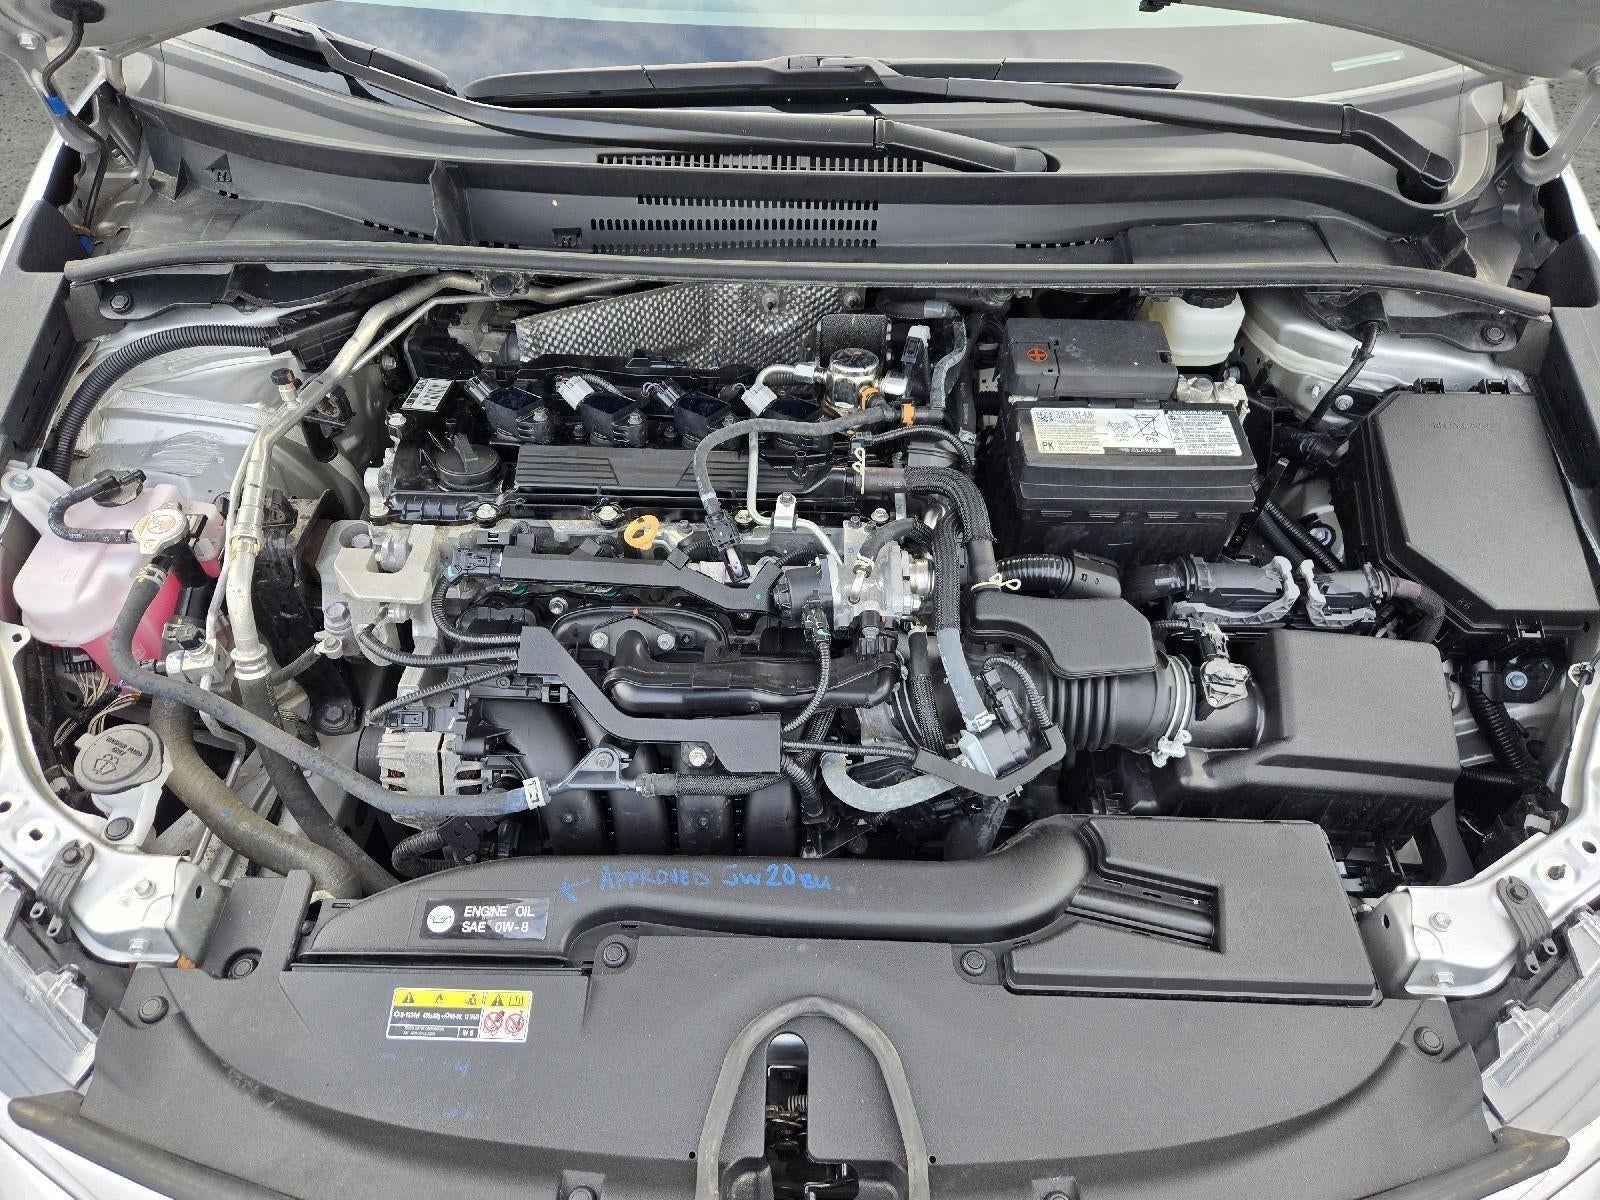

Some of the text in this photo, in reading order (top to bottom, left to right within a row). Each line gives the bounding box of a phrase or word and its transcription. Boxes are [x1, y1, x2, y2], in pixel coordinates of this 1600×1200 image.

[1042, 441, 1055, 450] PK
[463, 905, 535, 917] ENGINE OIL
[461, 921, 487, 933] SAE
